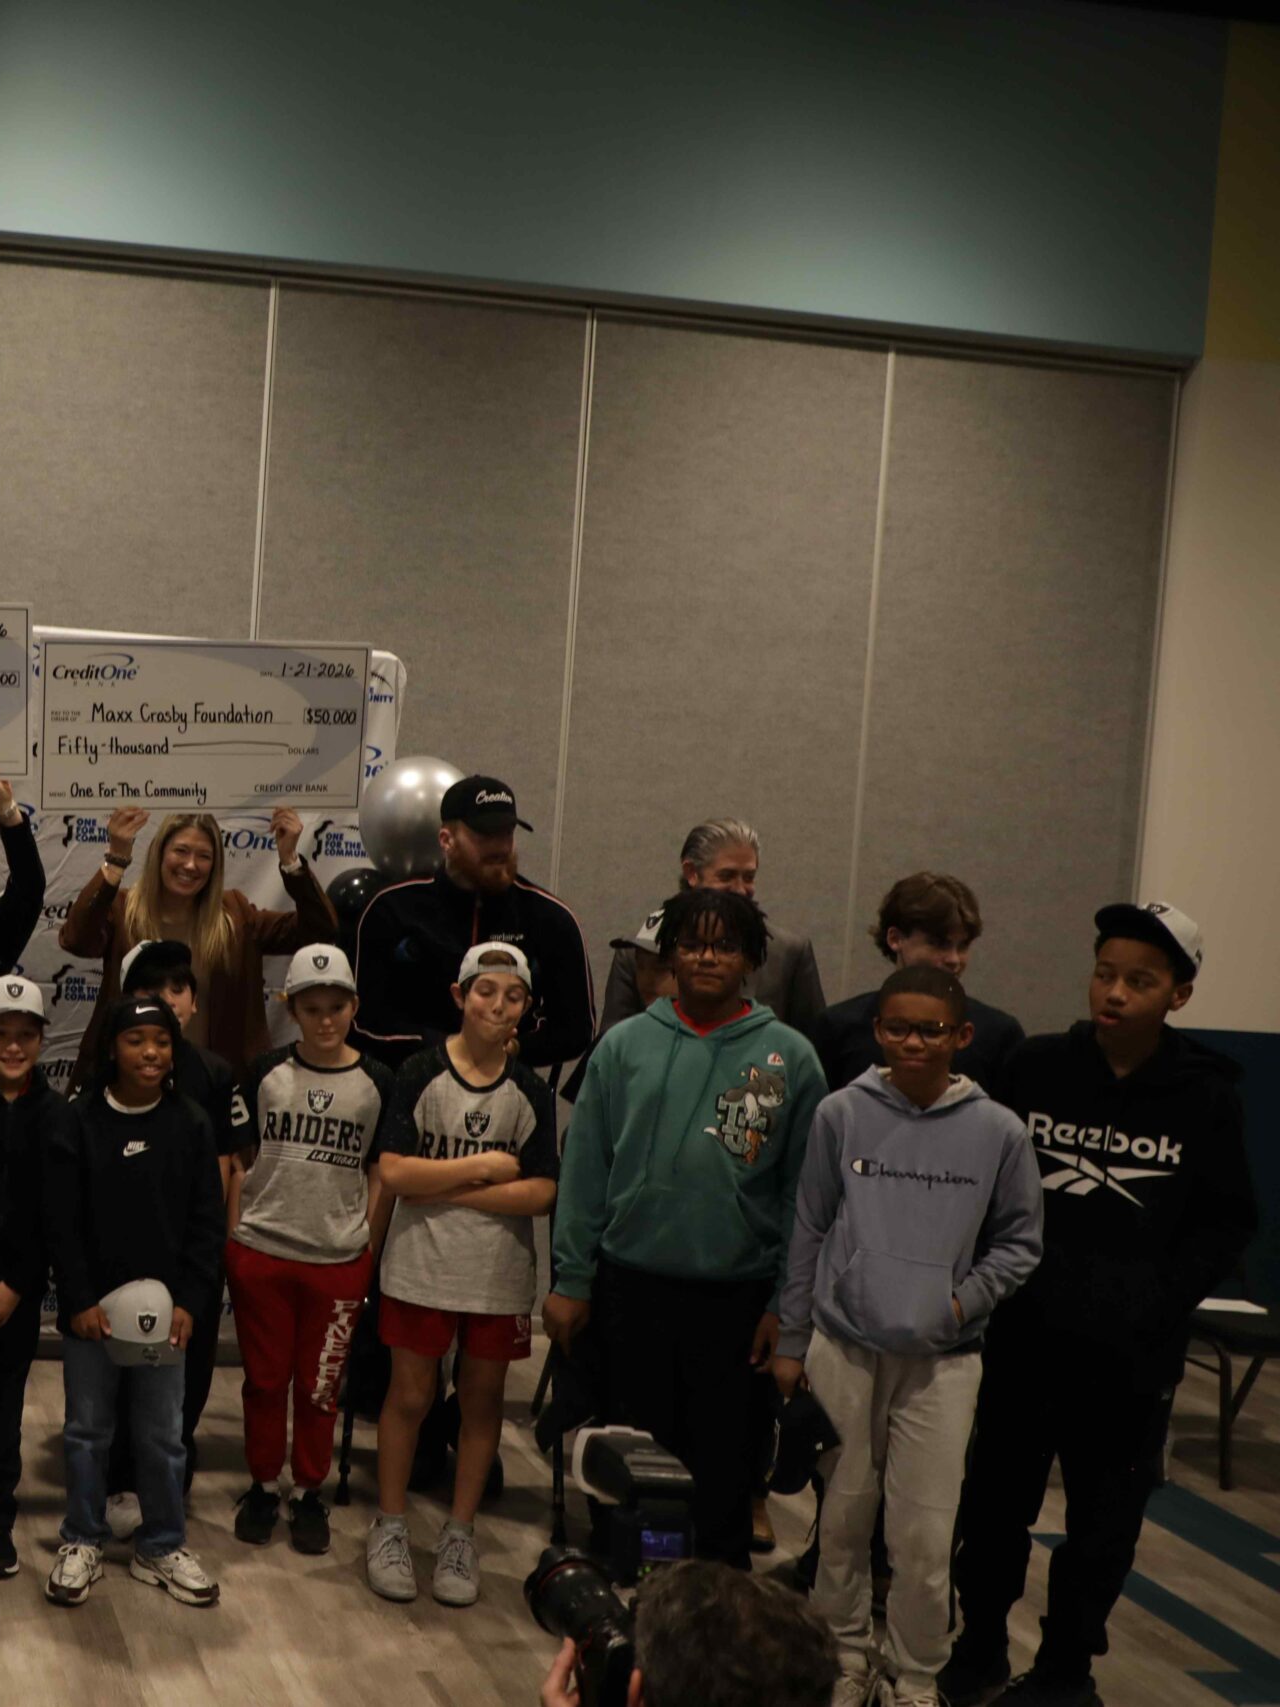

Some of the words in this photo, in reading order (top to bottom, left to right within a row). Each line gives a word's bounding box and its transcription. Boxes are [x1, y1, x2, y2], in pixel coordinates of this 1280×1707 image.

[52, 664, 137, 680] CreditOne
[91, 702, 133, 723] Maxx
[193, 703, 273, 723] Foundation
[288, 747, 319, 755] DOLLARS
[70, 782, 93, 797] One
[98, 783, 117, 797] For
[118, 782, 140, 797] The
[145, 780, 207, 805] Community
[254, 784, 283, 792] CREDIT
[285, 784, 304, 792] ONE
[305, 784, 328, 793] BANK
[76, 819, 96, 827] ONE
[66, 977, 86, 985] ONE
[65, 985, 84, 993] FOR
[263, 1112, 365, 1152] RAIDERS
[1027, 1111, 1183, 1165] Reebok
[311, 1150, 331, 1161] LAS
[851, 1159, 978, 1190] Champion
